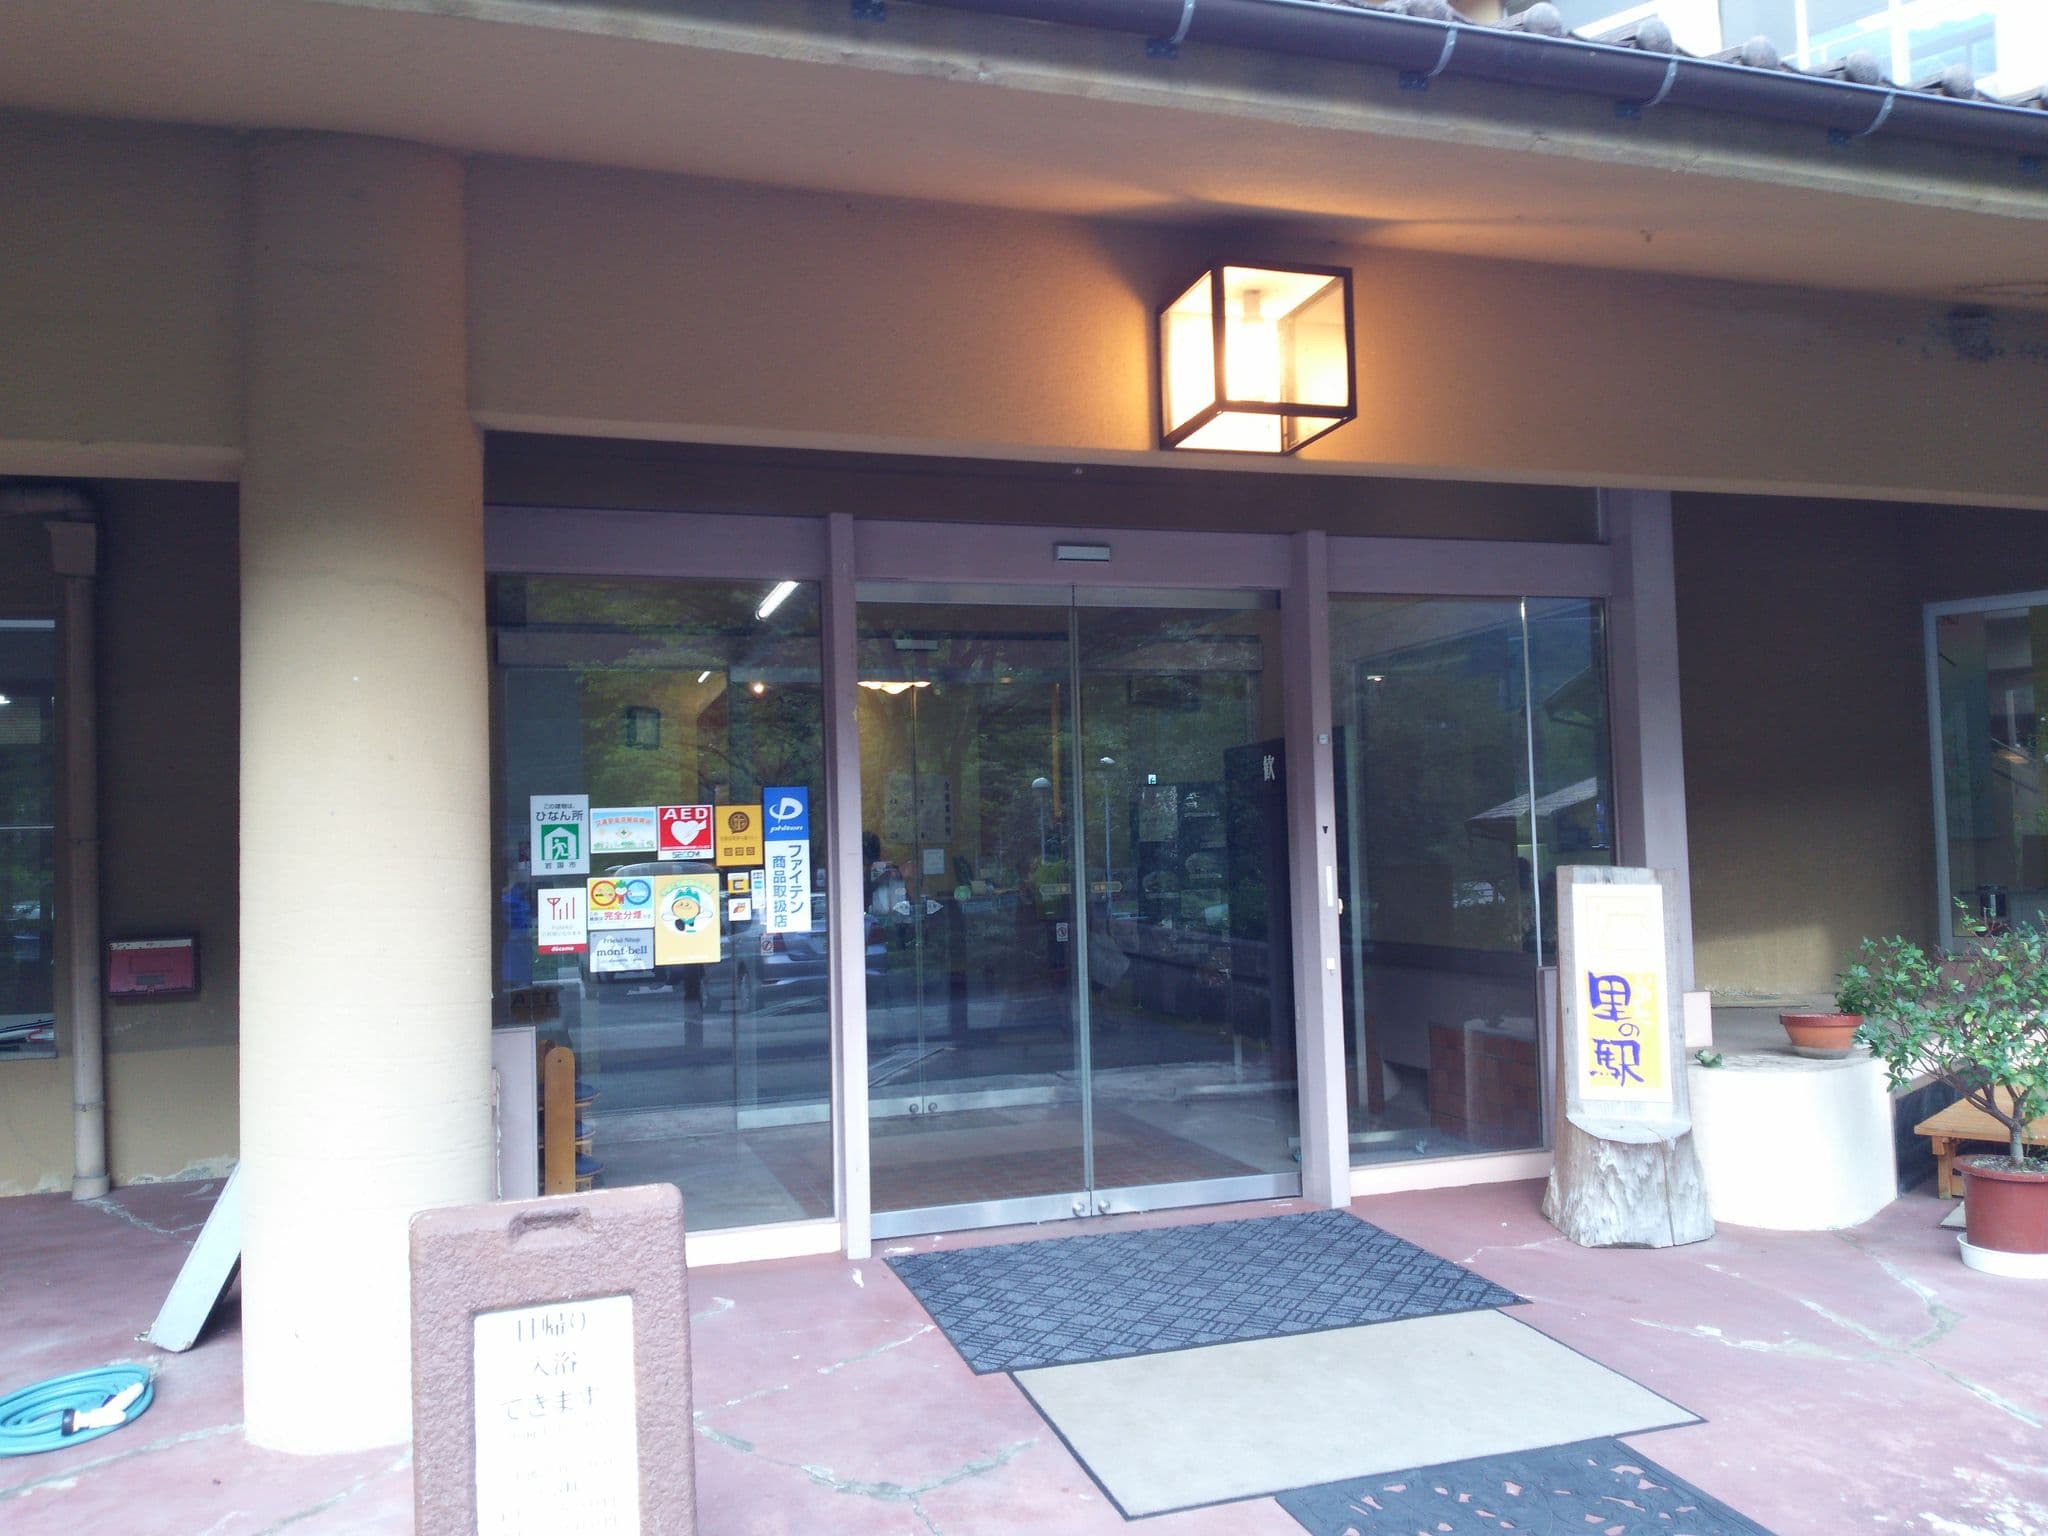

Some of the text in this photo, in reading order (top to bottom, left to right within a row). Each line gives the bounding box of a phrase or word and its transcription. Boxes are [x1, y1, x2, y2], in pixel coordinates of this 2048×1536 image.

[536, 810, 583, 821] ひなん所
[662, 808, 708, 820] AED
[772, 855, 787, 928] 商品取扱店
[788, 844, 805, 914] ファイテン
[604, 911, 642, 920] 完全分煙
[1588, 970, 1645, 1087] 里の駅
